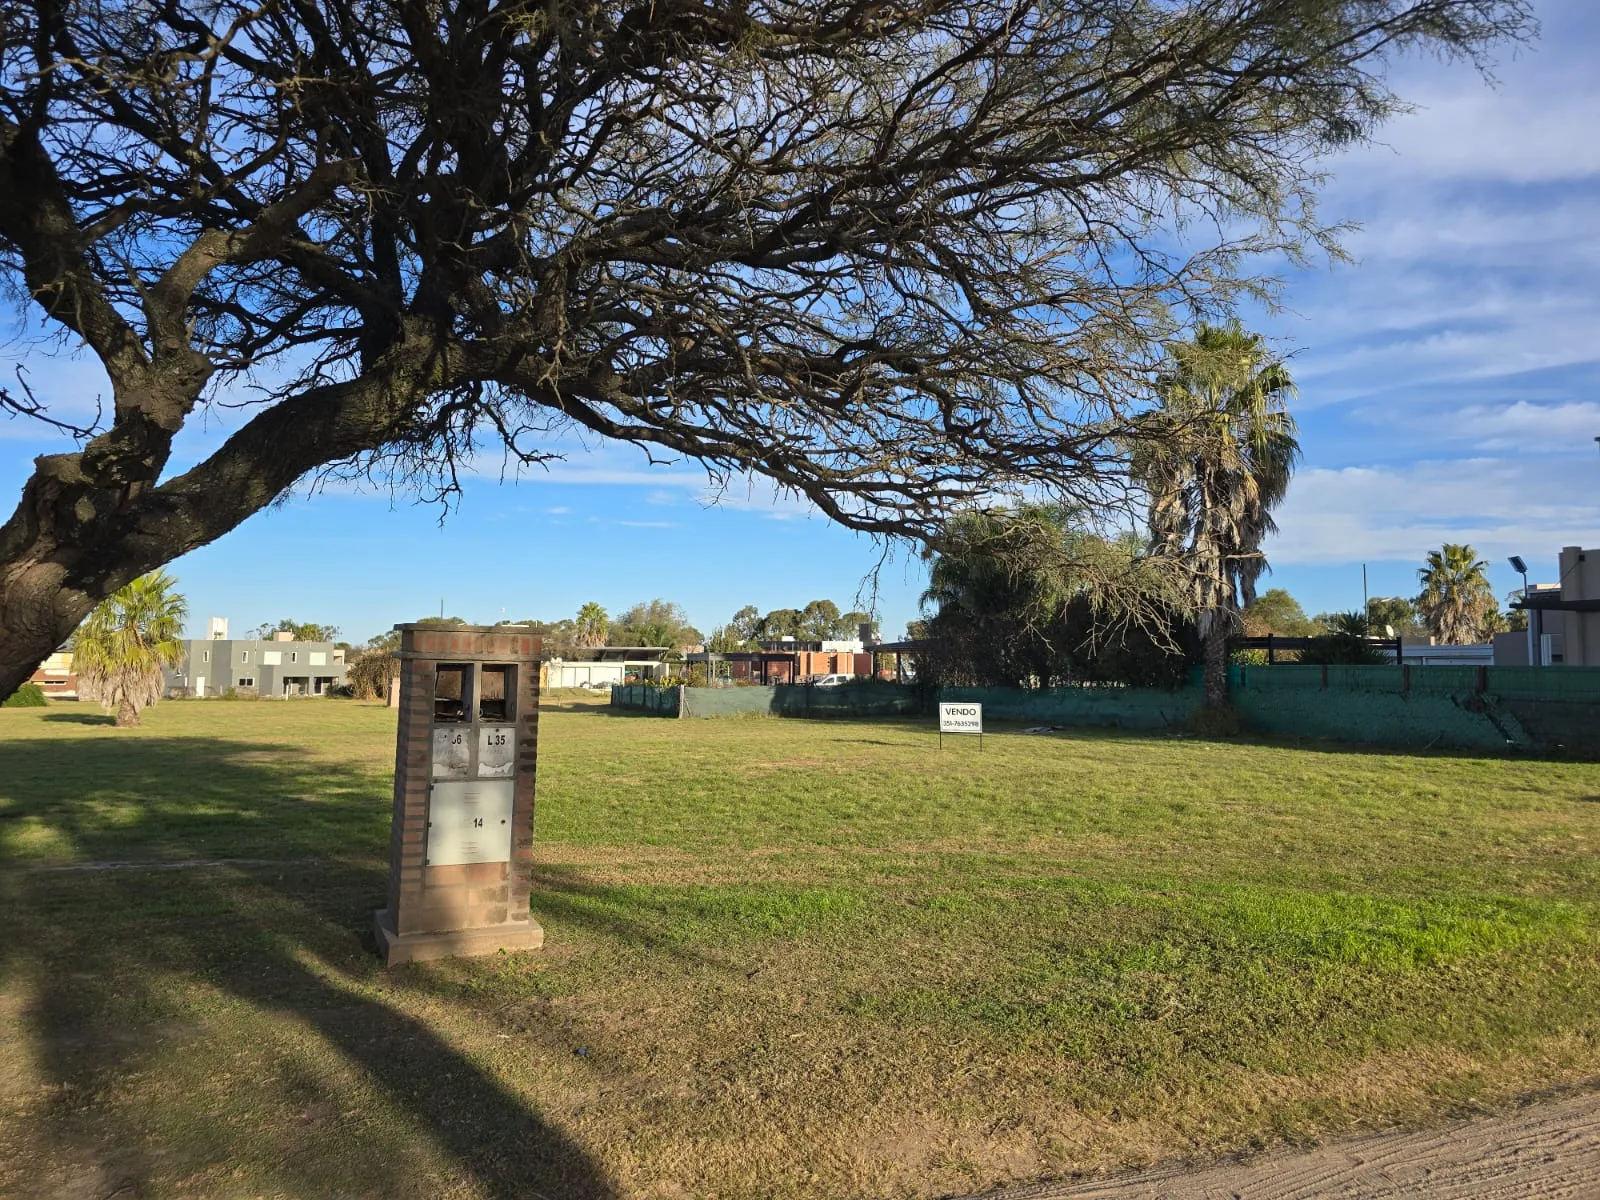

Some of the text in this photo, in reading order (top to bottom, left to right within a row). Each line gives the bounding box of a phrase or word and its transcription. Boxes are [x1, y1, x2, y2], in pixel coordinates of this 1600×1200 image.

[945, 708, 976, 716] VENDO
[487, 735, 506, 746] L 35
[473, 817, 483, 828] 14
